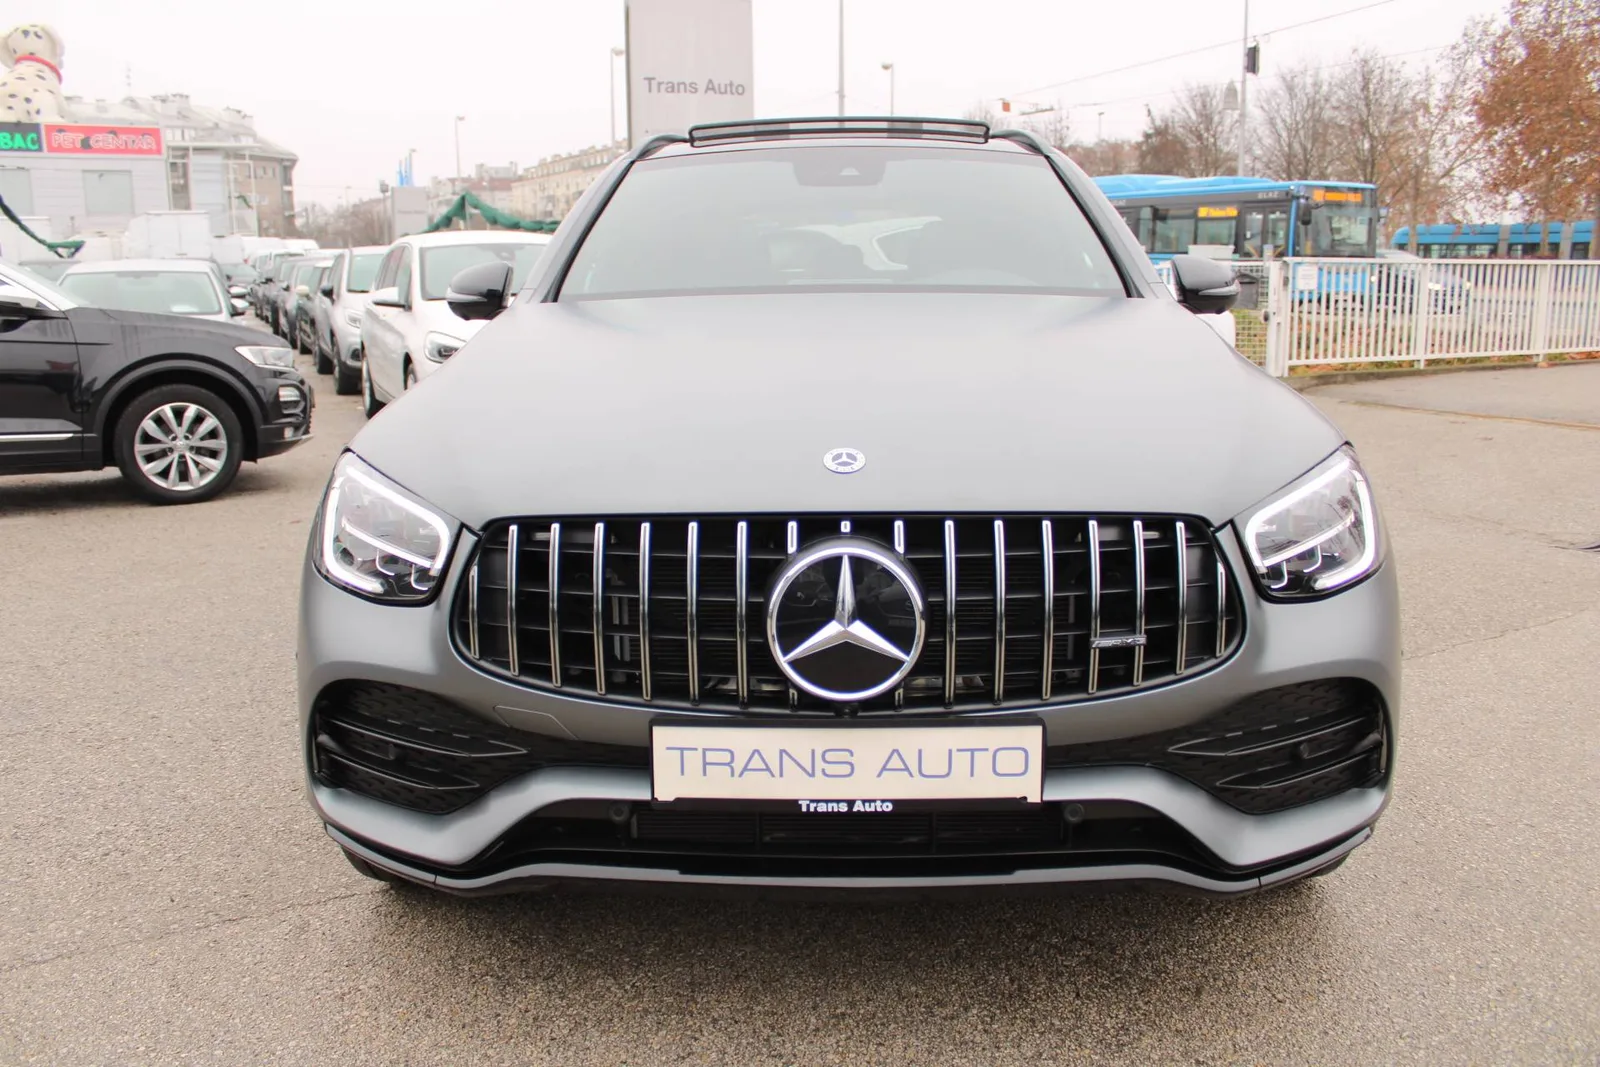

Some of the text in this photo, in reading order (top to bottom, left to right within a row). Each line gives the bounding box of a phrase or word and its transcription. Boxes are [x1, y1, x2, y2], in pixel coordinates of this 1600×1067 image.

[643, 77, 746, 96] Trans Auto
[51, 132, 157, 151] PET CENTAR
[666, 746, 1031, 779] TRANS AUTO
[798, 799, 893, 812] Trans Auto
